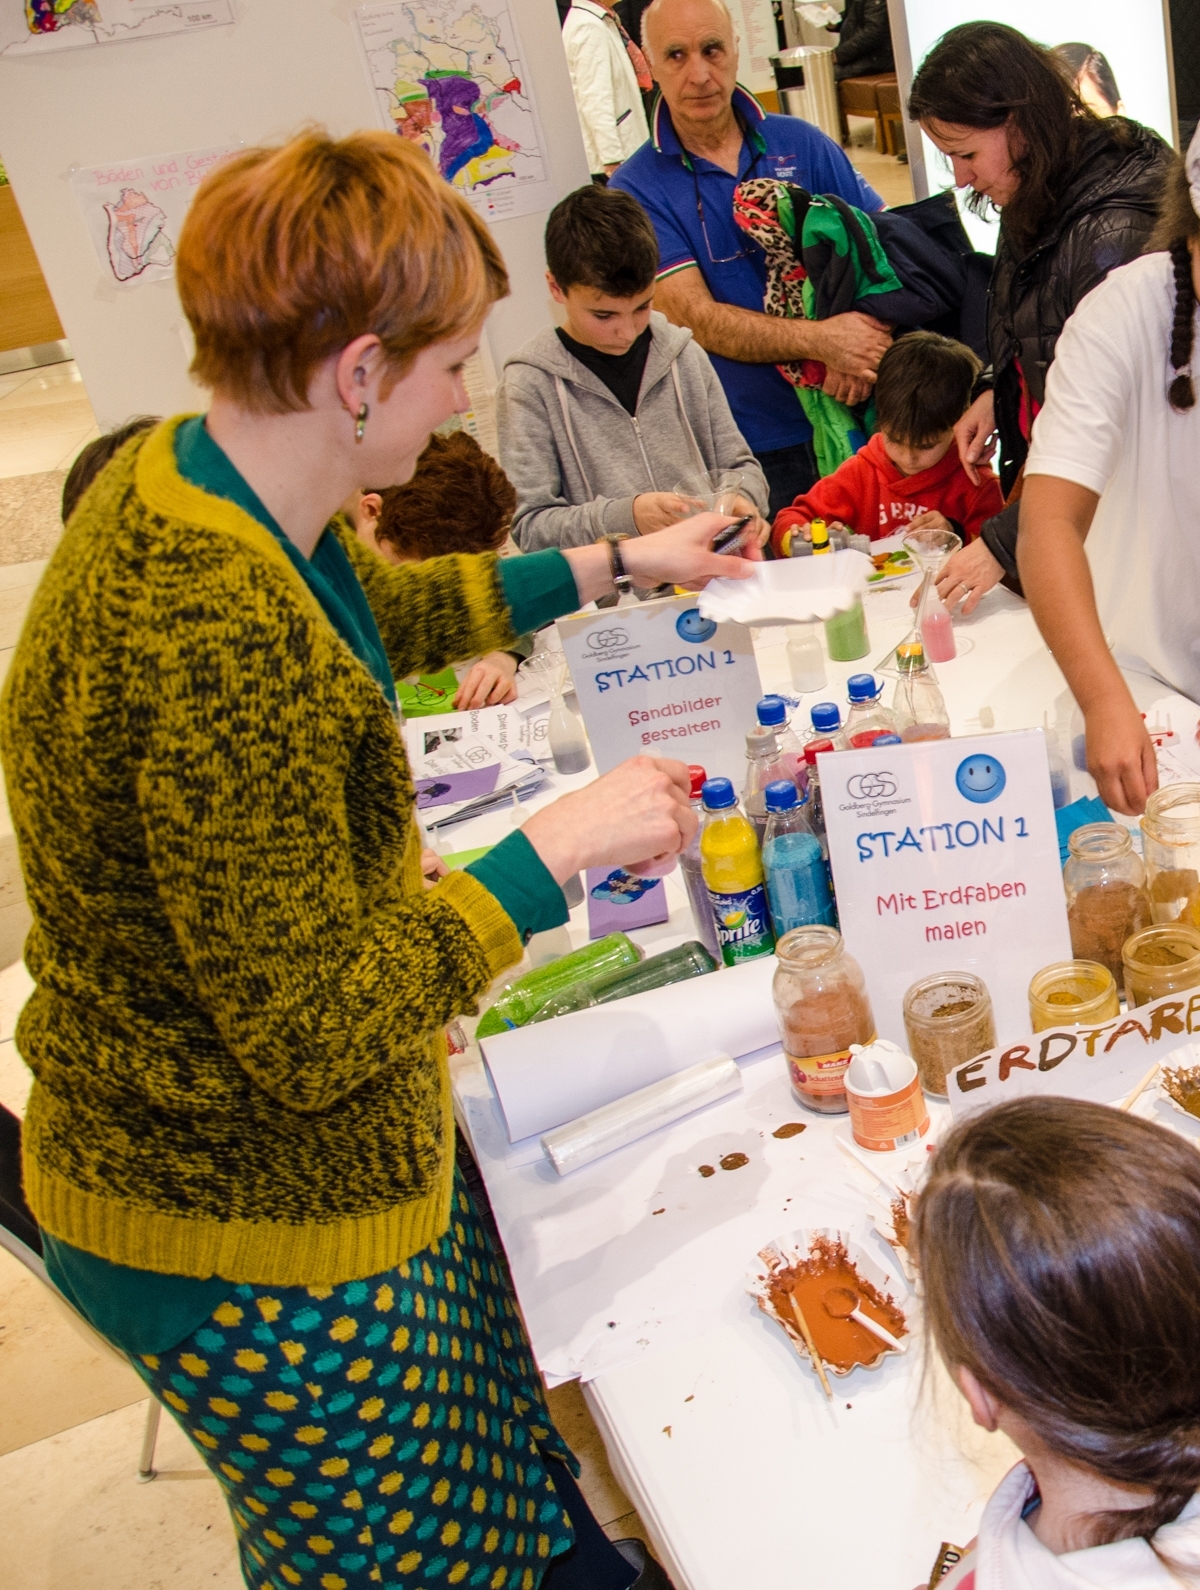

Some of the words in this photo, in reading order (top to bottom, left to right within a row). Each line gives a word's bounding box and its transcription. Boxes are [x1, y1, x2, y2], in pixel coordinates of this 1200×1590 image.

[92, 167, 145, 186] Böden
[152, 160, 179, 176] und
[150, 177, 180, 191] von
[595, 650, 717, 693] STATION
[722, 650, 736, 665] 1
[628, 696, 723, 727] Sandbilder
[641, 719, 722, 745] gestalten
[839, 797, 912, 812] Goldberg-Gymnasium
[856, 807, 898, 818] Sindelfingen
[856, 816, 1005, 863] STATION
[1014, 816, 1029, 838] 1
[876, 892, 918, 916] Mit
[922, 881, 1027, 910] Erdfaben
[925, 919, 987, 943] malen
[807, 1073, 845, 1082] Schattenm
